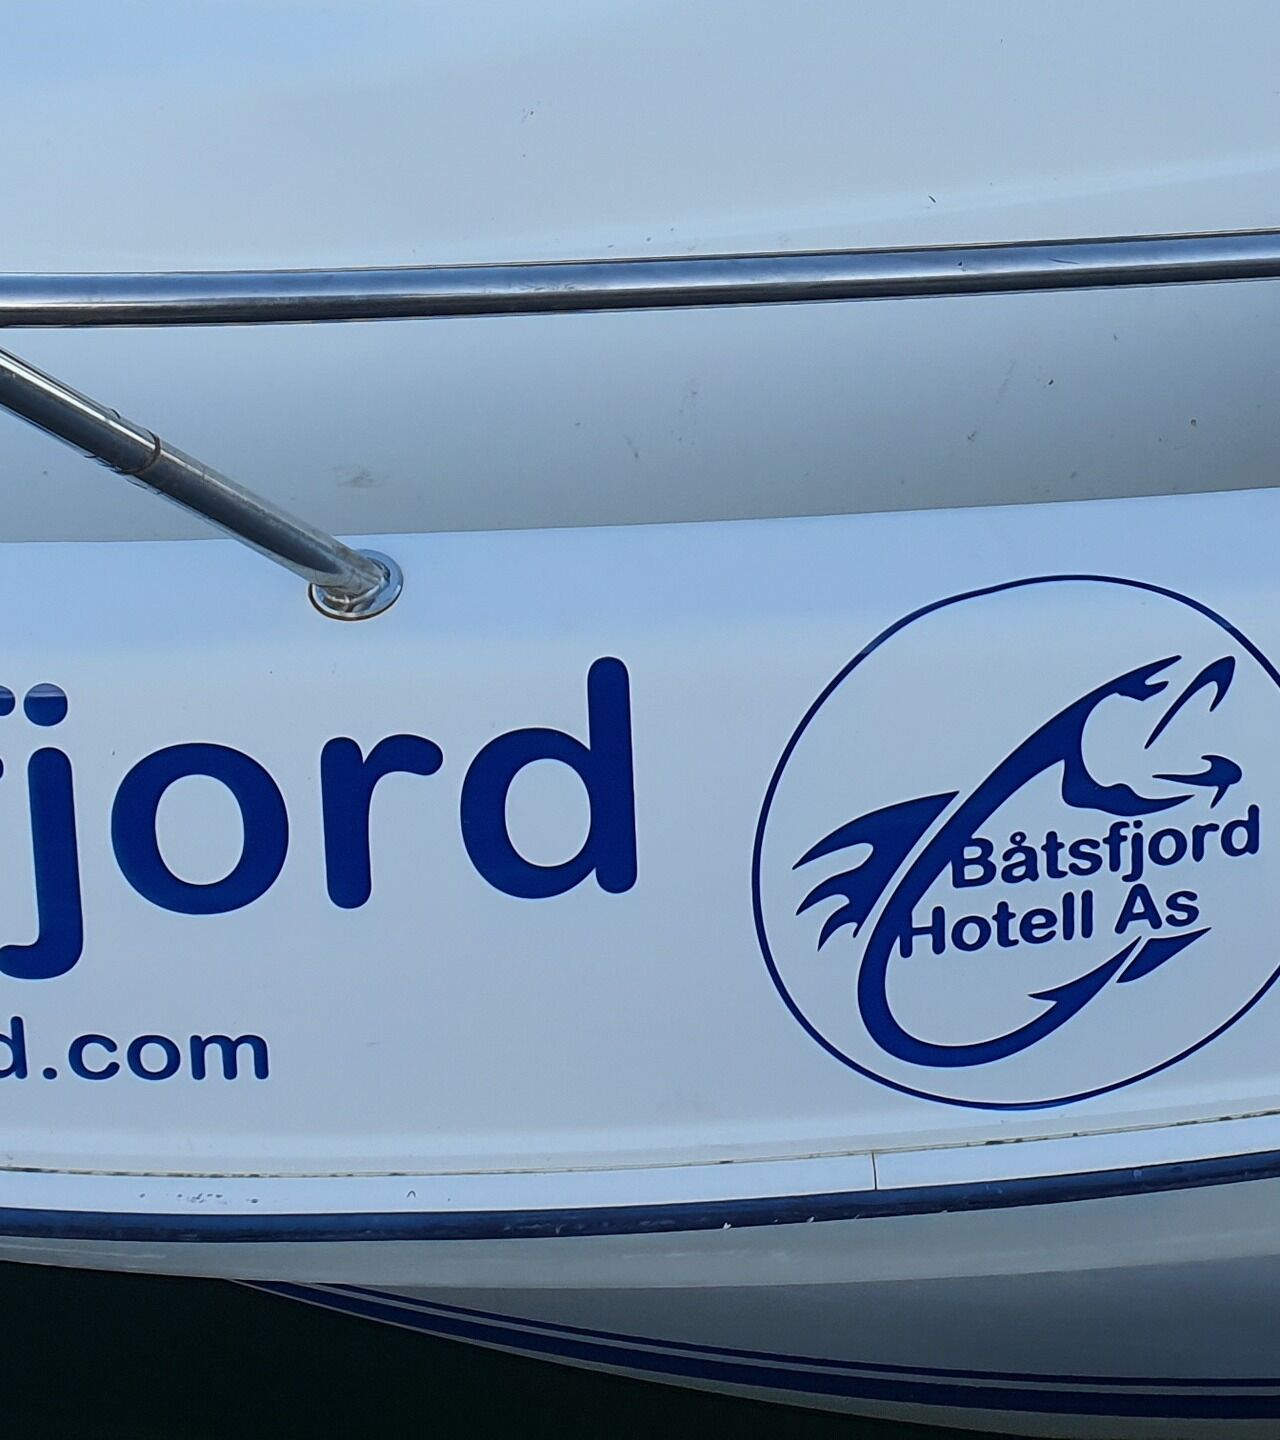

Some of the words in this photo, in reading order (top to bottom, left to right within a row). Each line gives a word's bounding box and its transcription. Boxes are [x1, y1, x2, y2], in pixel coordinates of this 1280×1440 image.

[950, 804, 1261, 884] Båtsfjord
[898, 891, 1095, 959] Hotell
[1114, 882, 1202, 937] As
